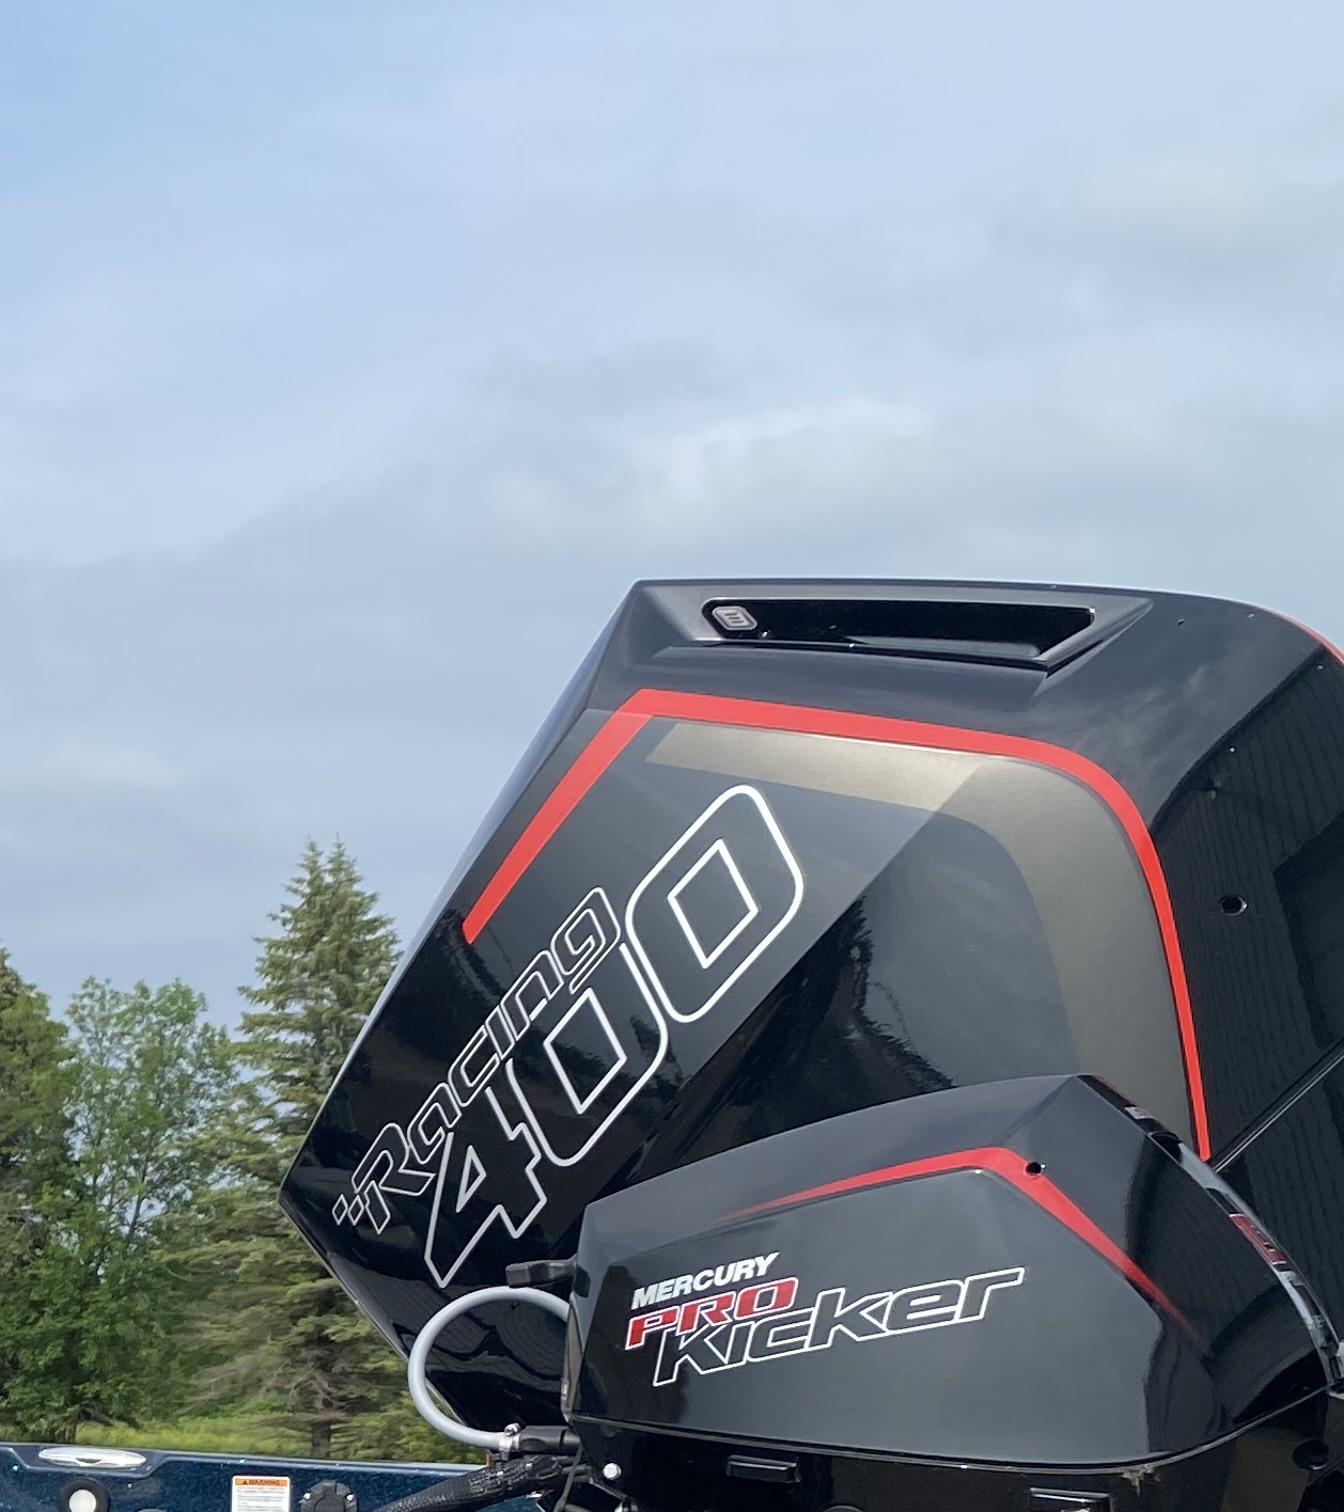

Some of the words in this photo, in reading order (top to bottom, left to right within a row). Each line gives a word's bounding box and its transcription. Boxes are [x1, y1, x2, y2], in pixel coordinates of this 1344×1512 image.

[332, 886, 622, 1235] Racing
[423, 784, 805, 1289] 400
[624, 1276, 799, 1350] PRO
[630, 1251, 780, 1310] MERCURY
